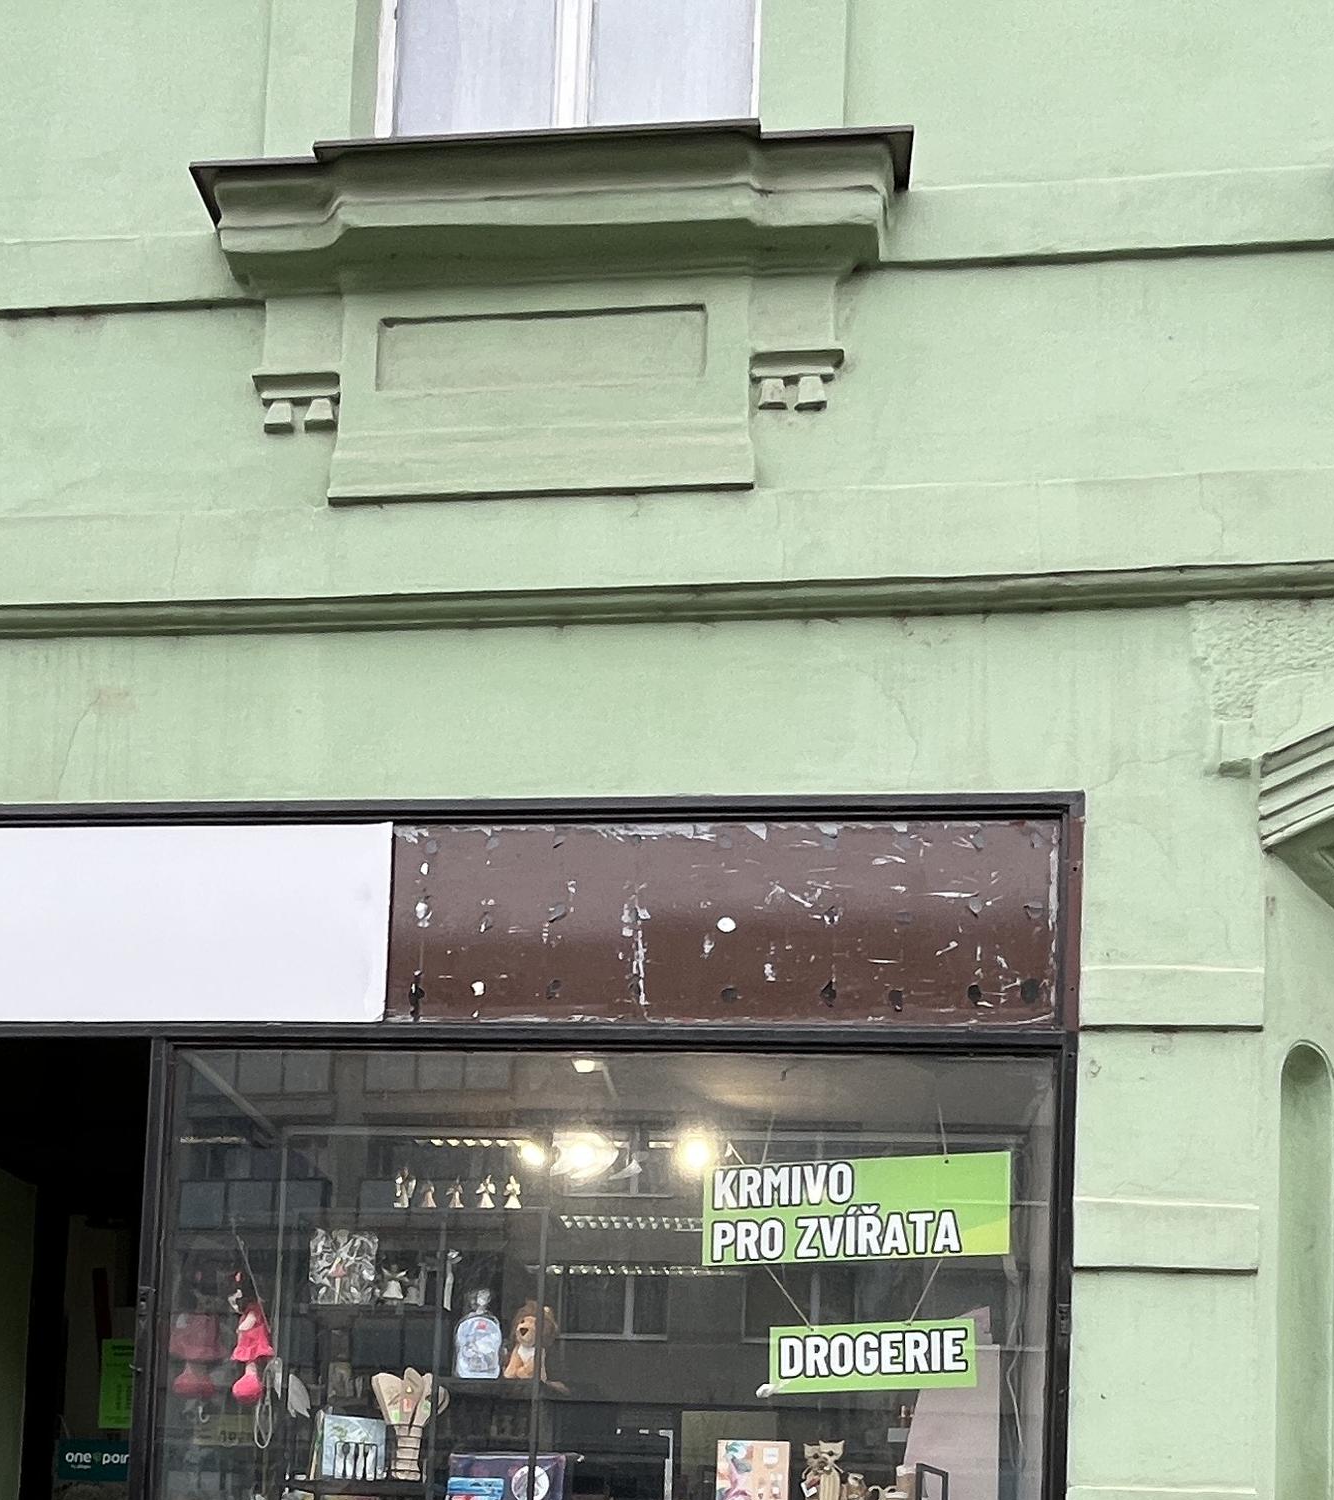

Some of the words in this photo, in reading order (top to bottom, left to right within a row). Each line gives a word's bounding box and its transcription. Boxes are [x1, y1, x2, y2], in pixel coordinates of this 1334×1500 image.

[712, 1162, 854, 1210] KRMIVO
[711, 1217, 785, 1263] PRO
[794, 1204, 961, 1259] ZVÍŘATA
[778, 1328, 968, 1379] DROGERIE
[65, 1452, 92, 1463] one
